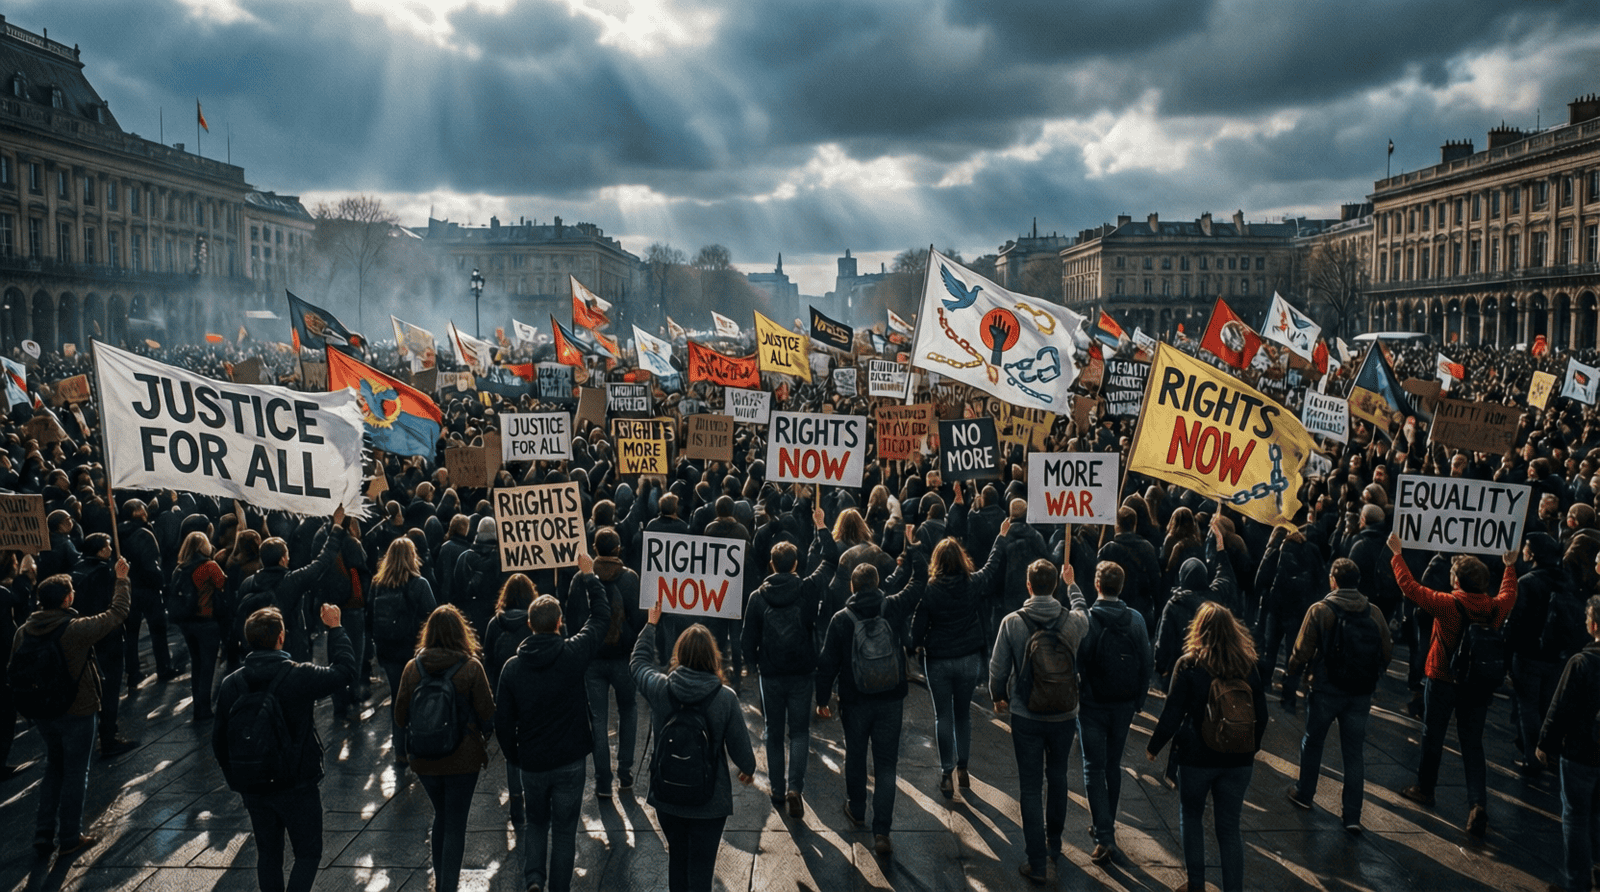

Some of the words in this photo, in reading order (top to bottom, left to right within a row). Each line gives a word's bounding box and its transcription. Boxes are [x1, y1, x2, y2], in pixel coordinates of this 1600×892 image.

[770, 349, 792, 367] ALL
[131, 372, 325, 445] JUSTICE
[1158, 366, 1281, 439] RIGHTS
[508, 416, 565, 437] JUSTICE
[775, 416, 859, 449] RIGHTS
[951, 422, 981, 447] NO
[140, 426, 232, 481] FOR
[244, 444, 332, 499] ALL
[512, 440, 536, 457] FOR
[539, 437, 566, 455] ALL
[623, 441, 661, 458] MORE
[947, 446, 995, 472] MORE
[1166, 415, 1257, 487] NOW
[626, 457, 659, 473] WAR
[778, 447, 851, 482] NOW
[1044, 459, 1104, 488] MORE
[1044, 490, 1095, 518] WAR
[1399, 480, 1524, 515] EQUALITY
[1398, 513, 1422, 542] IN
[1427, 515, 1517, 551] ACTION
[503, 544, 547, 567] WAR
[646, 538, 741, 578] RIGHTS
[658, 576, 730, 613] NOW
